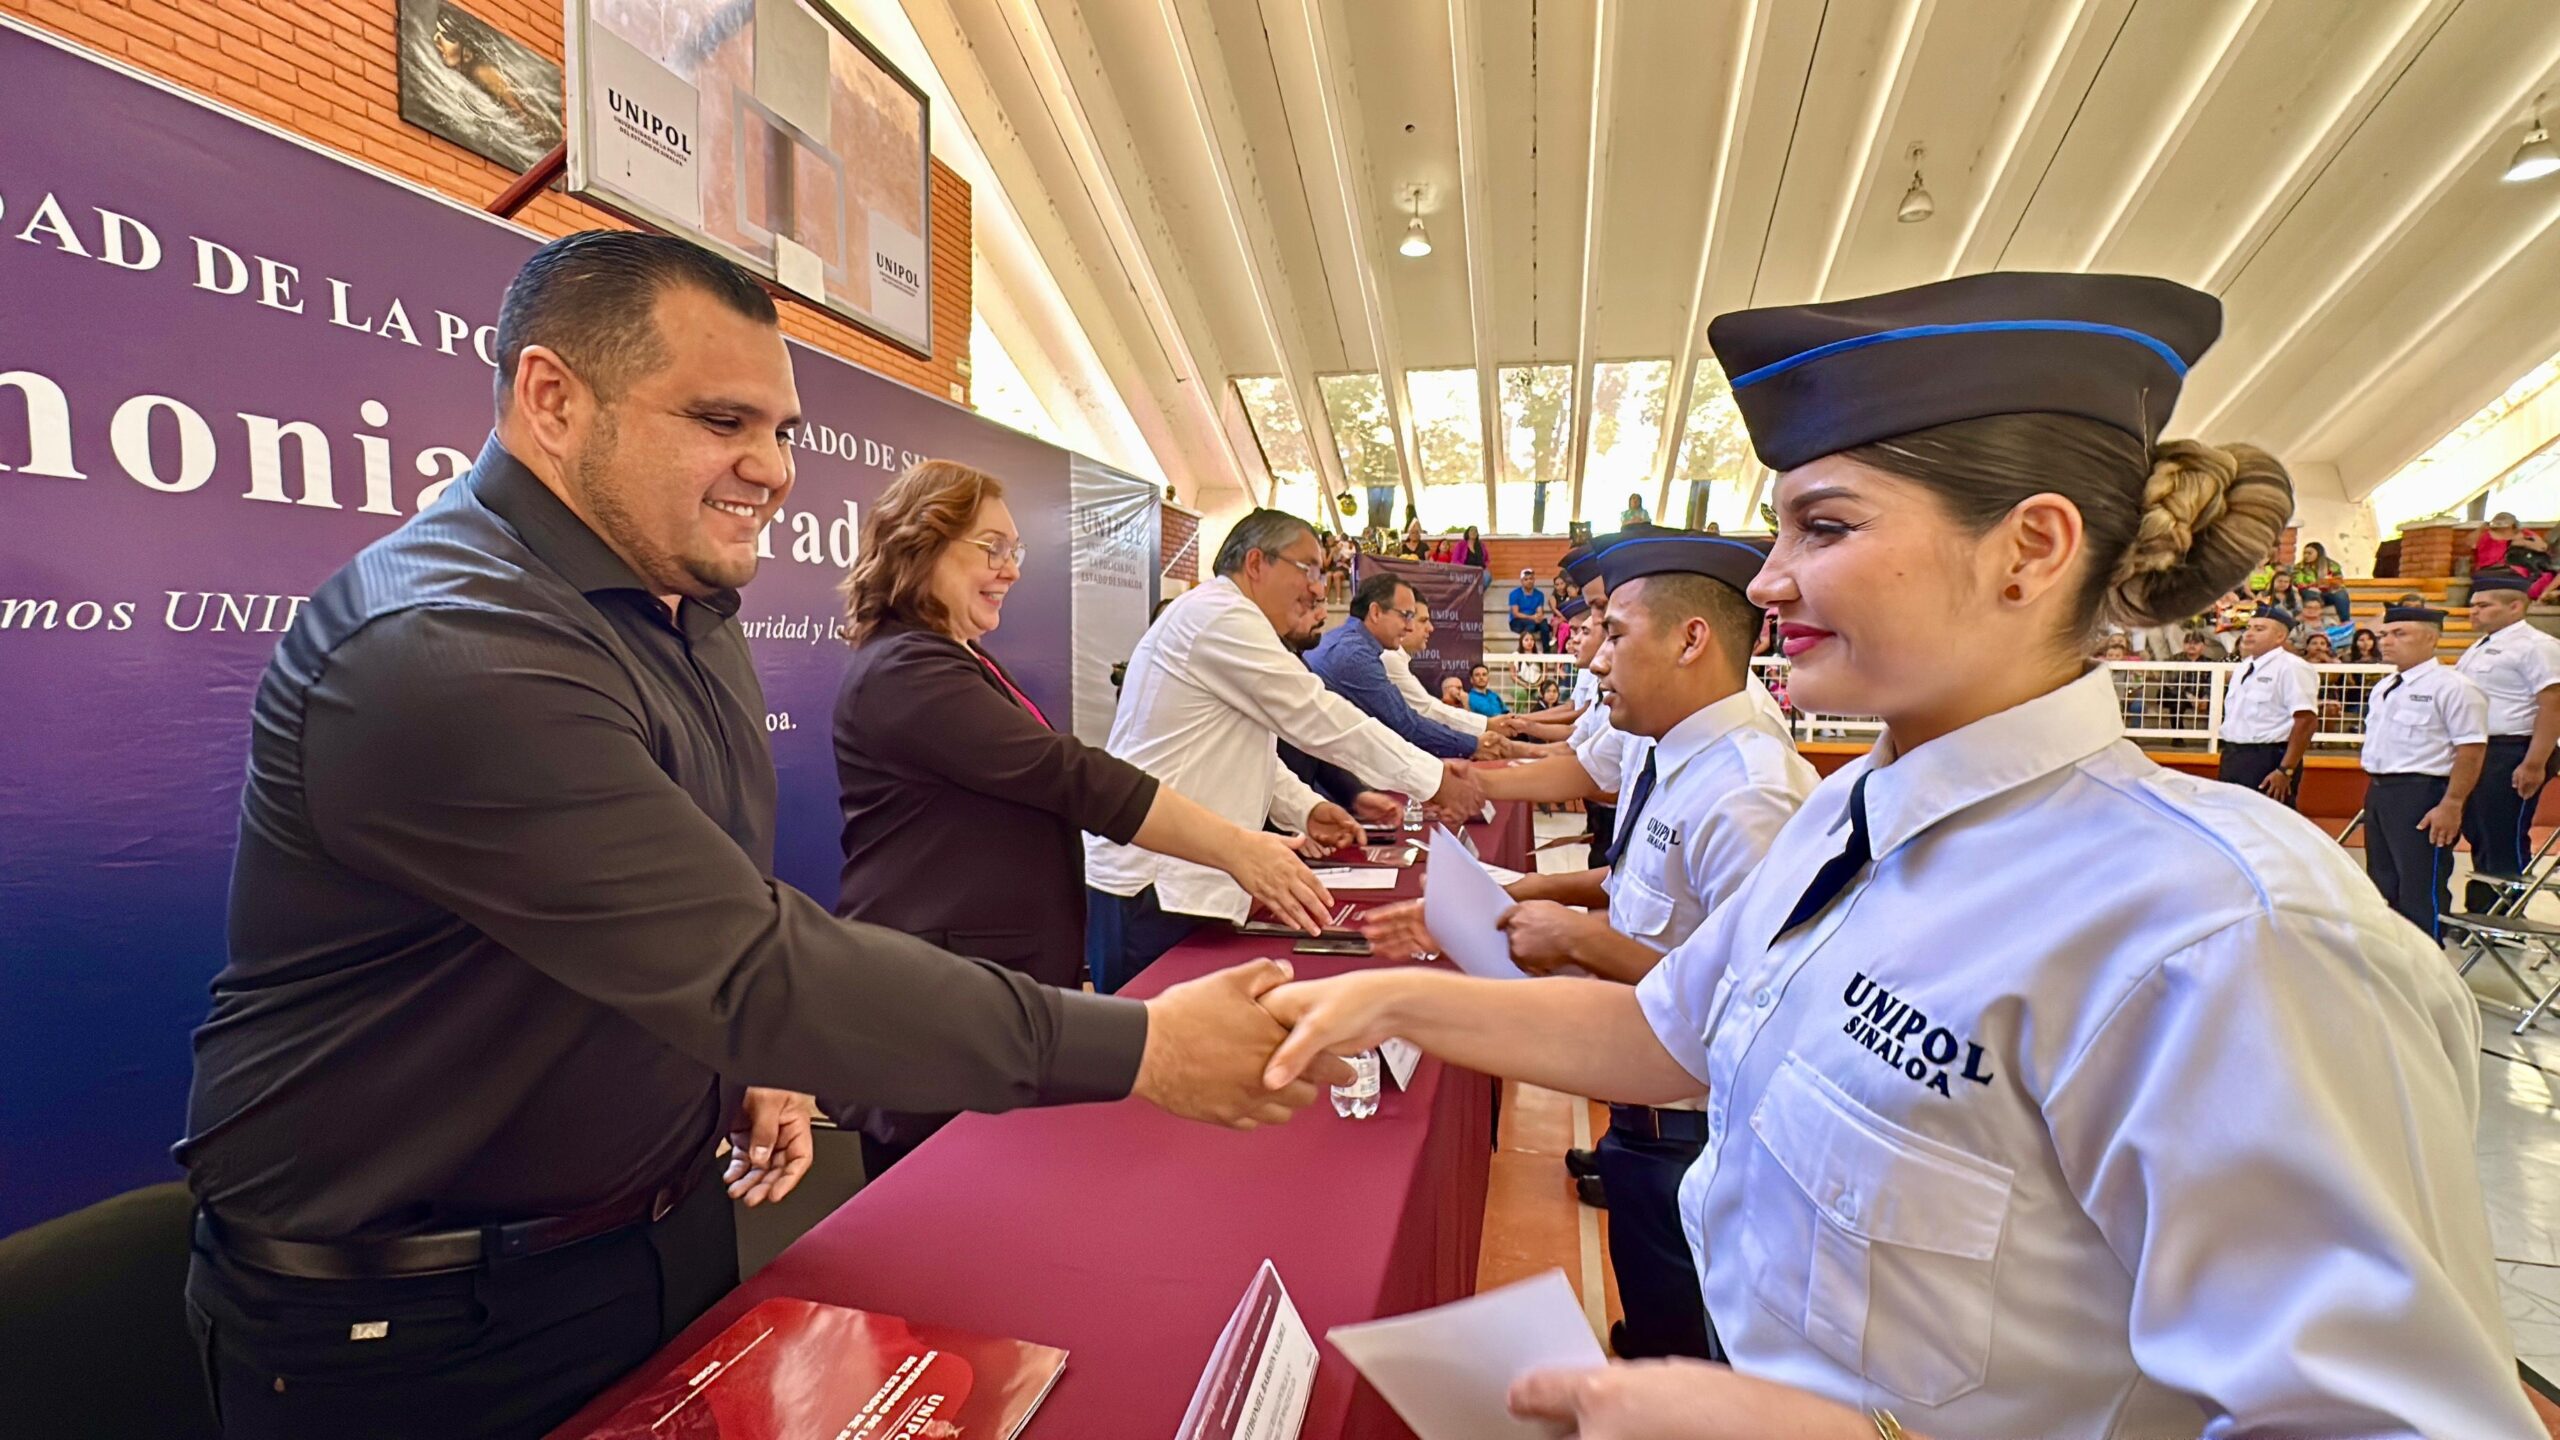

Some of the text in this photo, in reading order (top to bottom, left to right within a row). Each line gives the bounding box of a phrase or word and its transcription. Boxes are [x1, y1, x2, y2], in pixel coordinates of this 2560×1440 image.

[608, 87, 692, 156] UNIPOL
[0, 192, 162, 271] AD
[189, 235, 304, 314] DE
[326, 277, 422, 346] LA
[876, 251, 920, 288] UNIPOL
[863, 438, 896, 472] DE
[811, 623, 823, 645] y
[1647, 817, 1681, 846] UNIPOL
[1843, 971, 1994, 1086] UNIPOL
[1843, 1015, 1951, 1099] SINALOA
